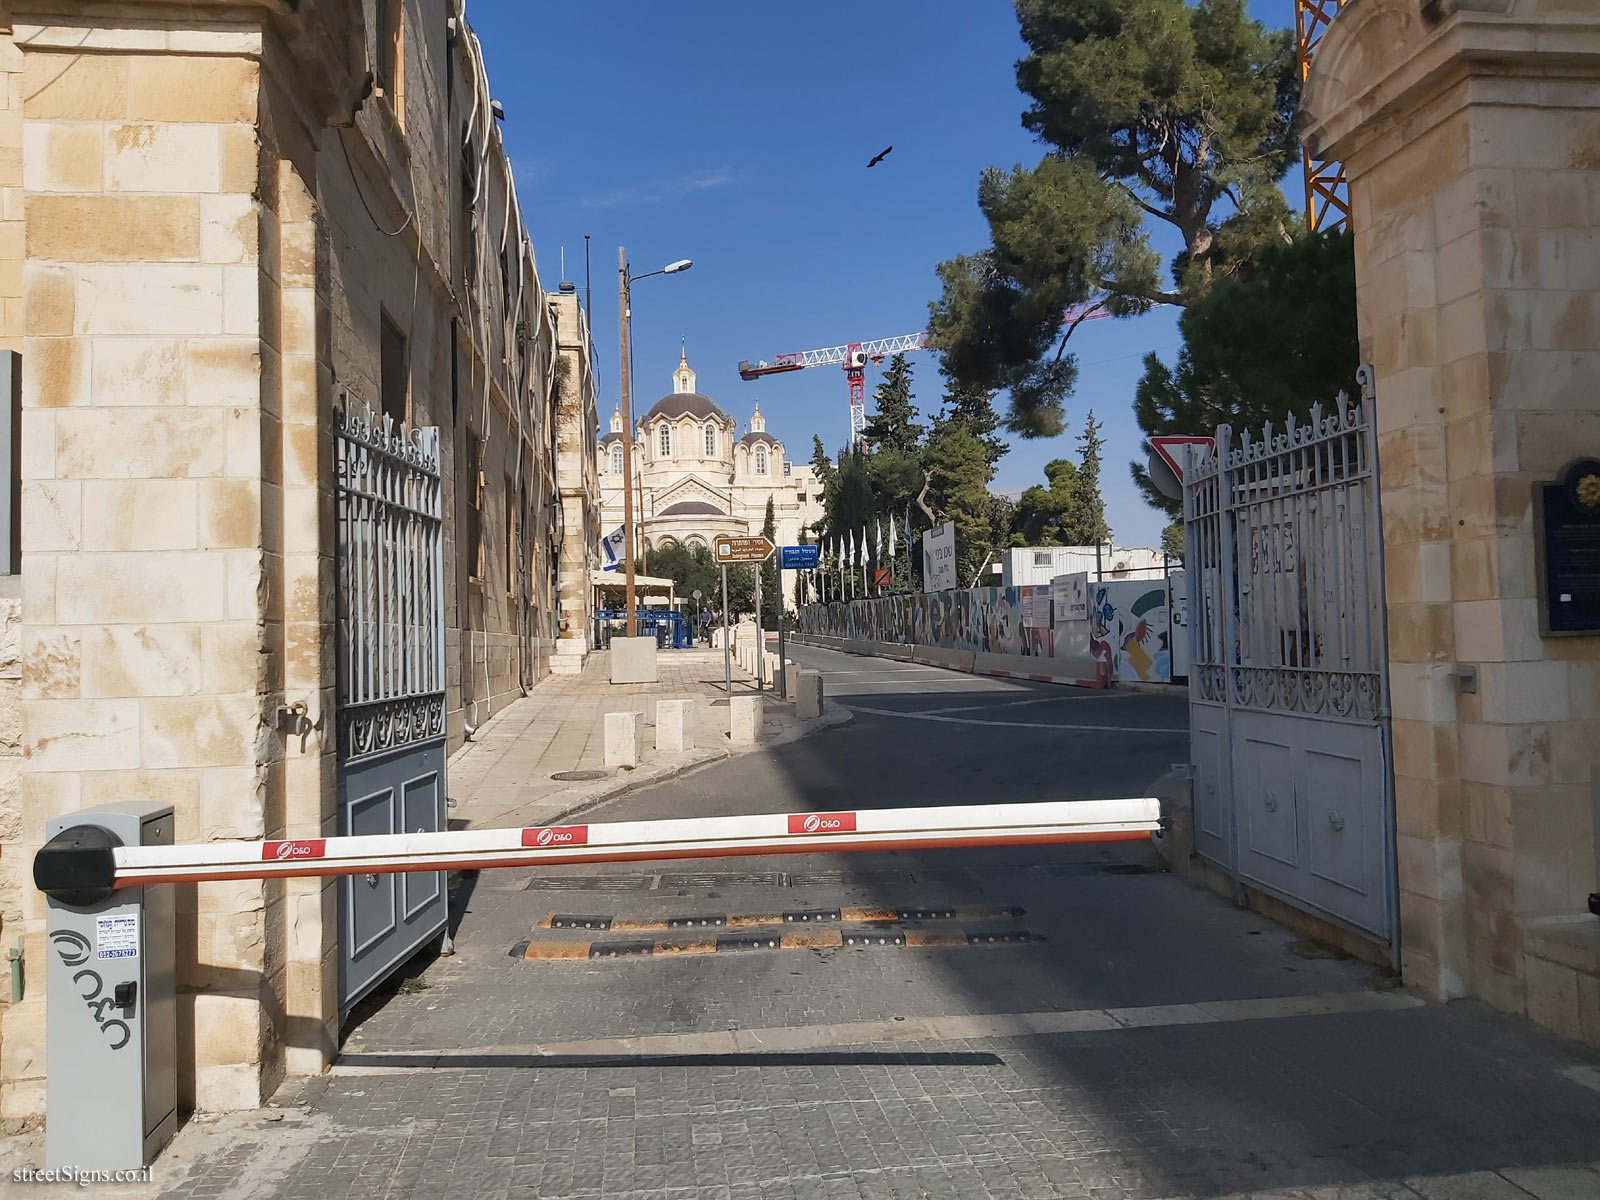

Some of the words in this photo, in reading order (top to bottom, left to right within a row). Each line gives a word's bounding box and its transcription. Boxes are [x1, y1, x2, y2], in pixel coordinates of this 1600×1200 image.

[820, 819, 840, 828] O&O
[553, 832, 573, 842] O&O
[292, 846, 310, 854] O&O
